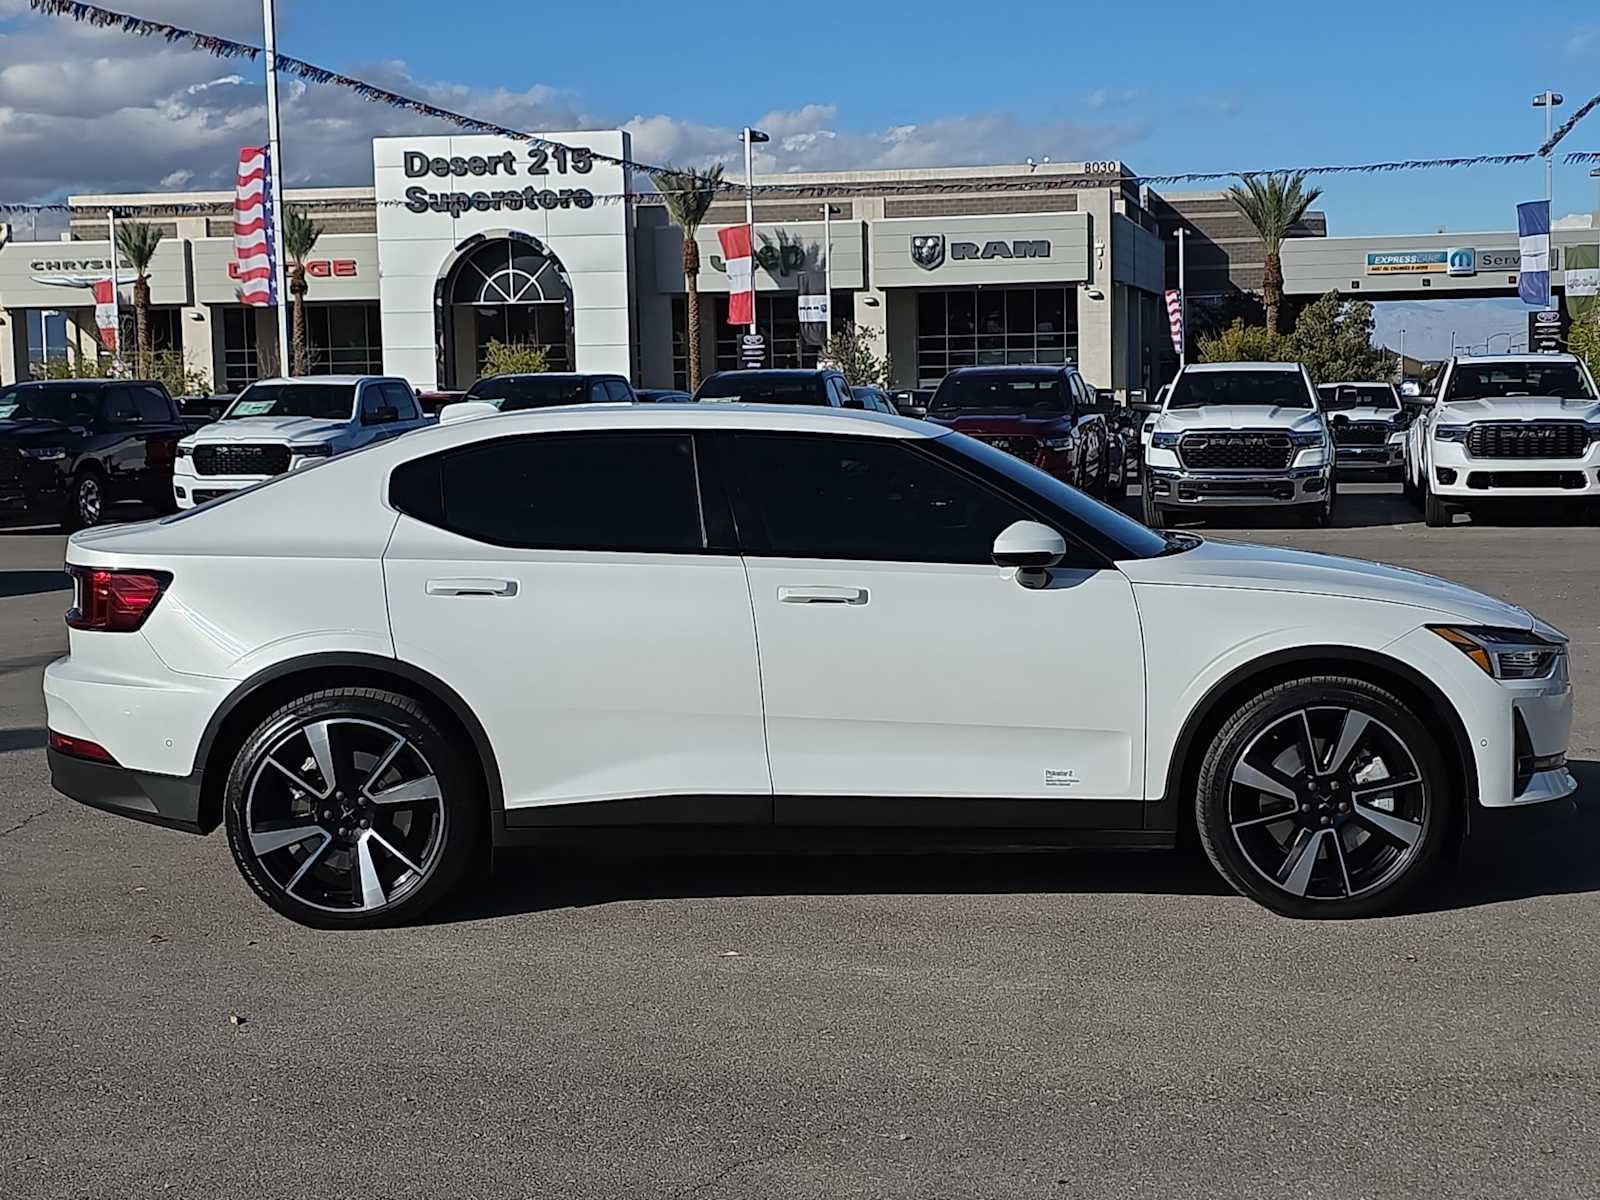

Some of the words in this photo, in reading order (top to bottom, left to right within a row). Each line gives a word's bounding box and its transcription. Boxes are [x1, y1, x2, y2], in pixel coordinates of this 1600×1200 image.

[403, 150, 517, 177] Desert
[527, 147, 593, 175] 215
[1084, 162, 1116, 174] 8030
[404, 185, 594, 218] Superstore
[950, 240, 1051, 260] RAM
[1374, 255, 1417, 264] EXPRESS
[1209, 438, 1264, 446] RAM
